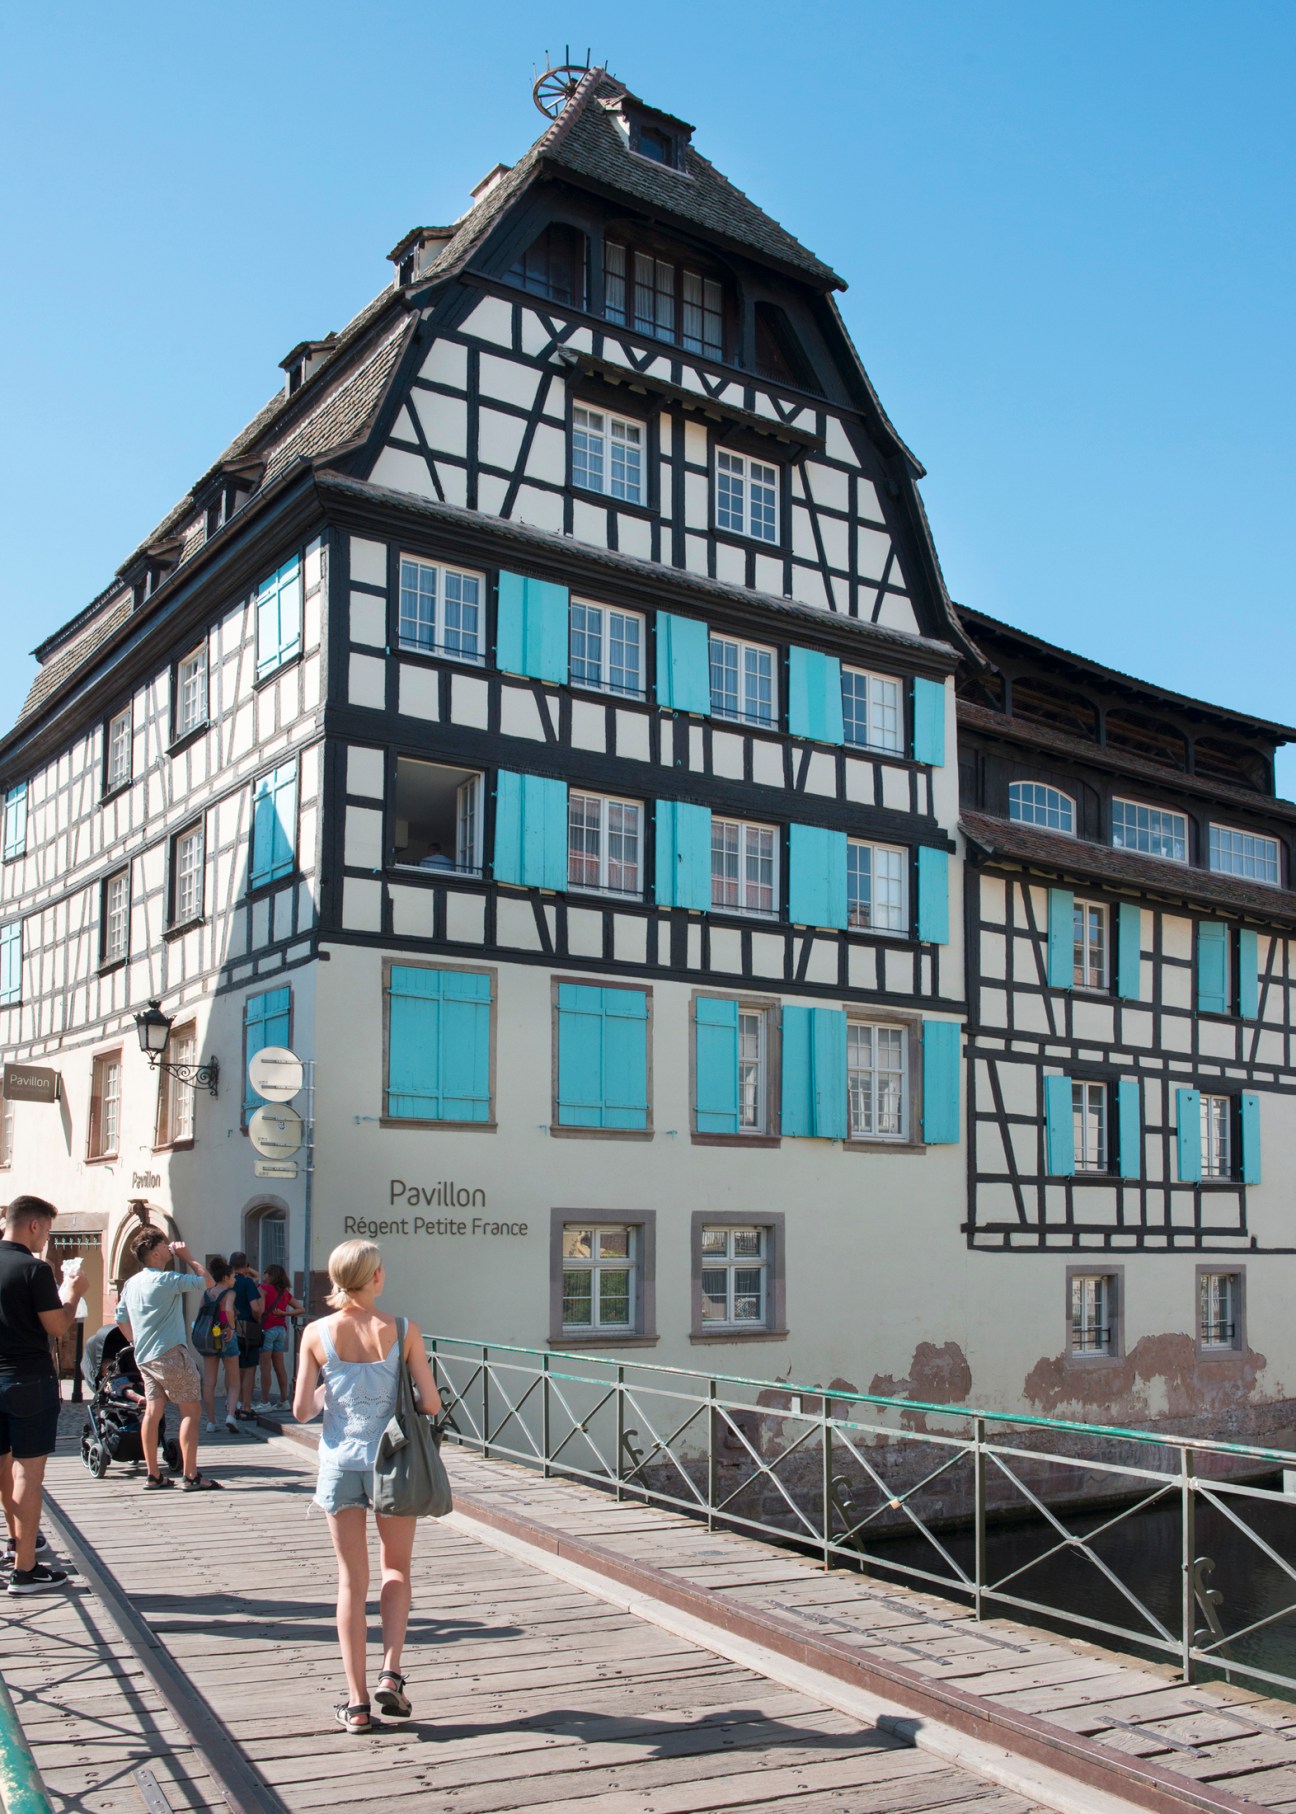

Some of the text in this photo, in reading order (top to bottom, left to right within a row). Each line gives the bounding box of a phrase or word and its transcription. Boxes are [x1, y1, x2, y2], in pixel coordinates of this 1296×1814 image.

[9, 1074, 50, 1088] Pavillon
[132, 1170, 161, 1189] Pavillon
[390, 1179, 486, 1207] Pavillon
[344, 1215, 528, 1239] Régent Petite France
